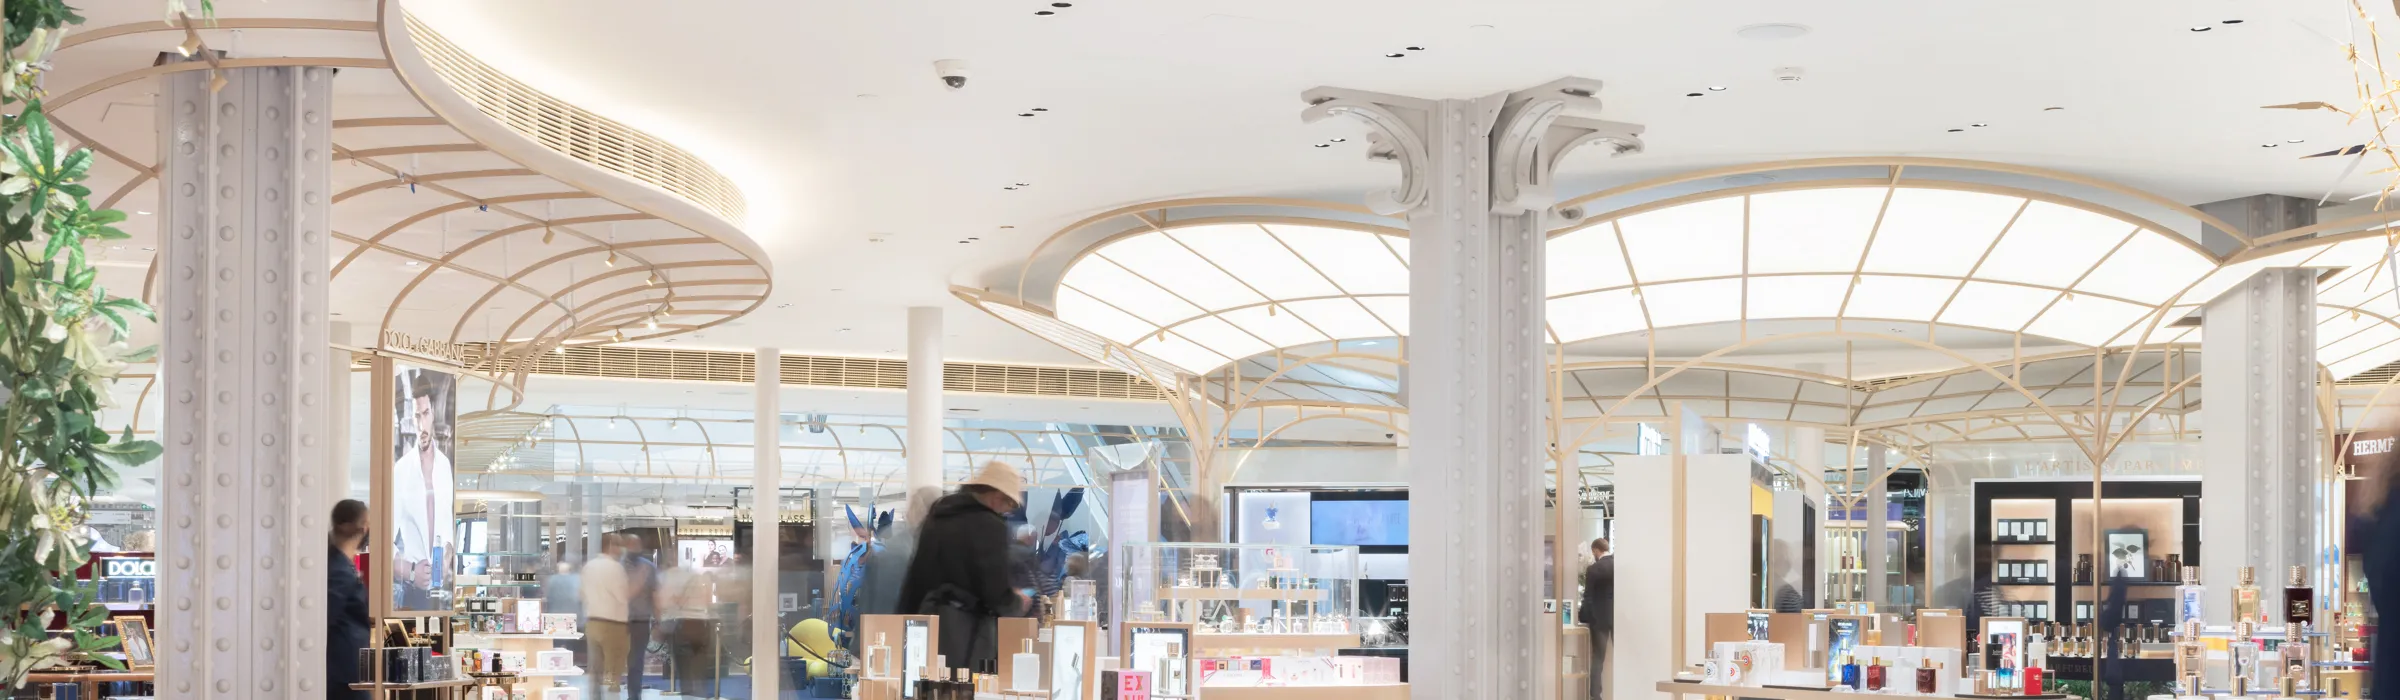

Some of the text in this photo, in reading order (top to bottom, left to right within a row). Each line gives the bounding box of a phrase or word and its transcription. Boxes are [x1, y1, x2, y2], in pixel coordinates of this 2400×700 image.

[2025, 459, 2115, 471] L'ARTISN
[709, 528, 734, 536] BROW
[1124, 675, 1144, 691] EX
